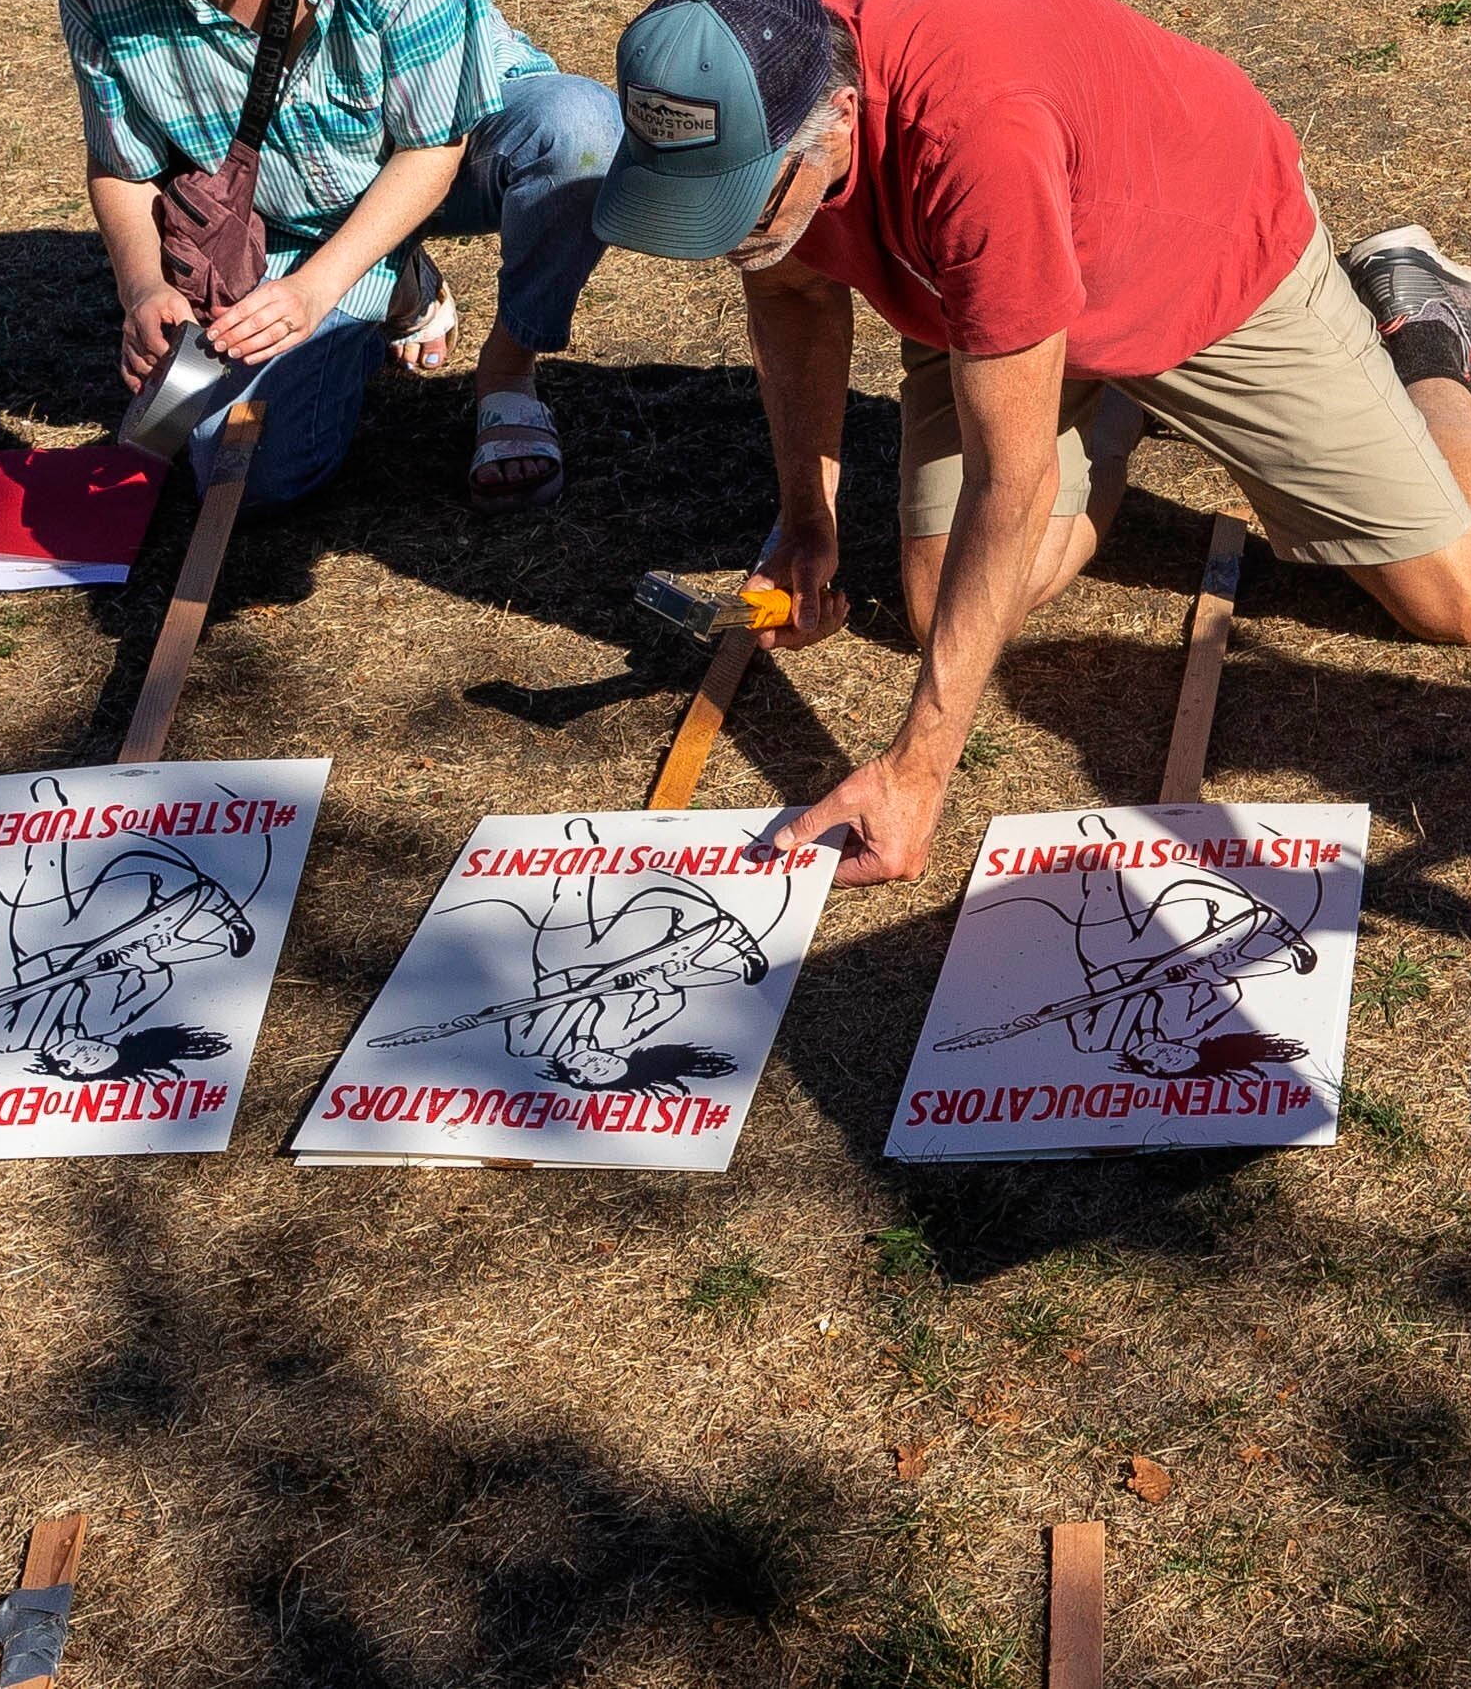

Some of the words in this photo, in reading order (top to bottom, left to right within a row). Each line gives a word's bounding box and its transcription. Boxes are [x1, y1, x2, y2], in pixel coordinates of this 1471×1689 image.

[985, 838, 1341, 877] #LISTENTOSTUDENTS
[322, 1084, 731, 1136] #LISTENTOEDUCATORS
[907, 1080, 1312, 1125] #LISTENTOEDUCATORS
